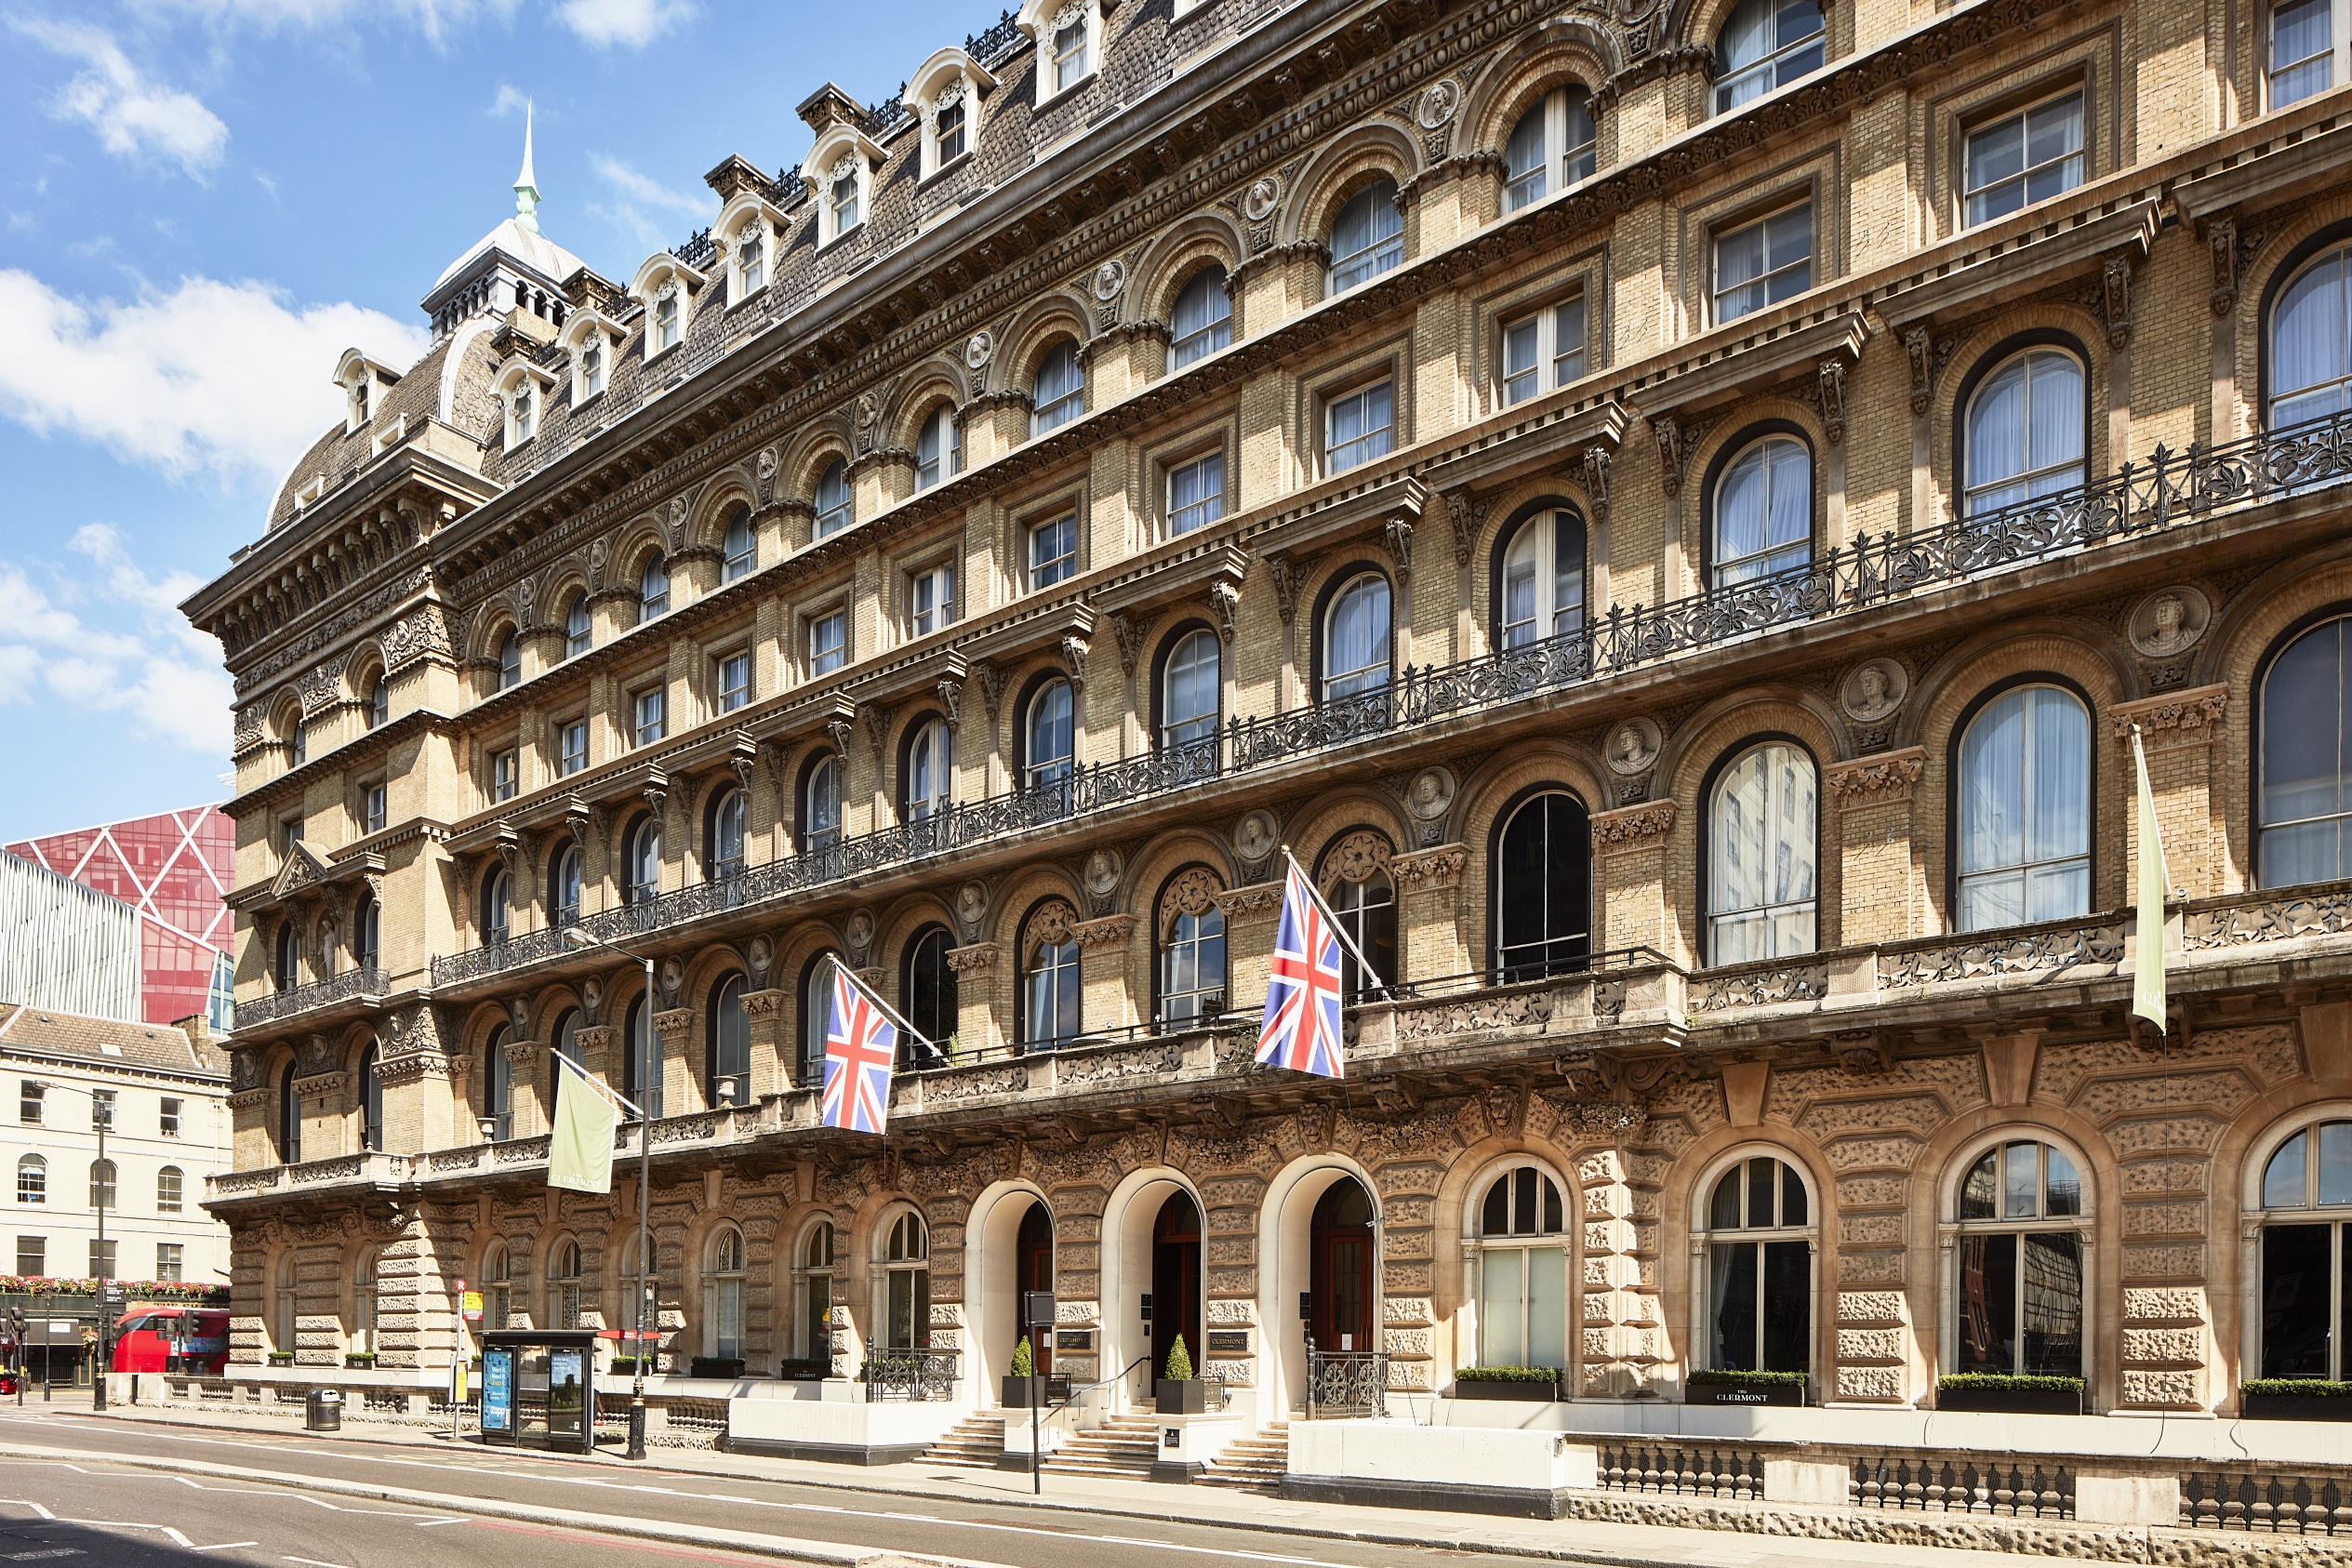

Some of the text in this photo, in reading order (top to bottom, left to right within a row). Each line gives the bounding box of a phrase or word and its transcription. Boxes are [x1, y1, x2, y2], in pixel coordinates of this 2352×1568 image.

[551, 1175, 602, 1188] CLERMONT
[458, 1281, 465, 1290] R
[491, 1405, 506, 1417] Zapp
